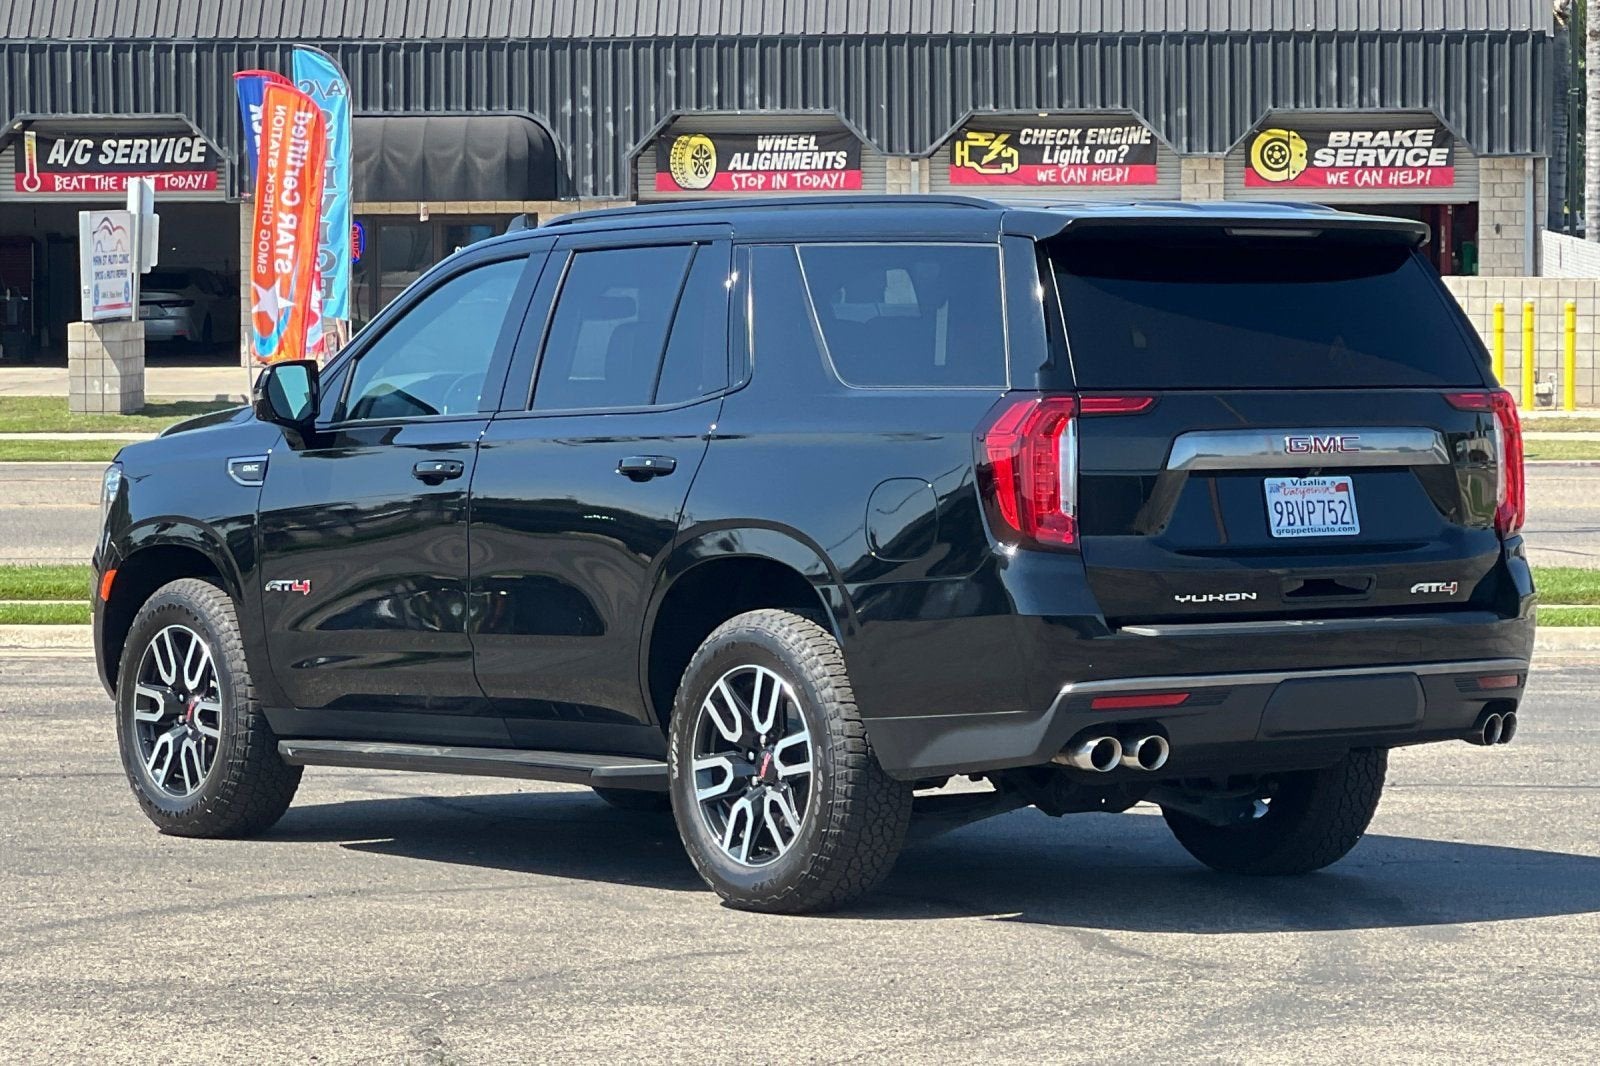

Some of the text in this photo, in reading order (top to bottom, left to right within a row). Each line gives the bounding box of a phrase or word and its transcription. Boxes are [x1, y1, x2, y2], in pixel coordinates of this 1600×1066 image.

[757, 134, 819, 152] WHEEL
[1019, 126, 1152, 146] CHECK ENGINE
[1327, 129, 1436, 148] BRAKE
[47, 137, 207, 167] A/C SERVICE
[728, 151, 847, 171] ALIGNMENTS
[1042, 145, 1130, 168] Light on?
[1313, 147, 1449, 168] SERVICE
[54, 174, 91, 191] BEAT
[90, 174, 118, 190] THE
[122, 174, 160, 190] HT
[731, 172, 766, 190] STOP
[771, 173, 787, 189] IN
[1037, 167, 1129, 184] WE CAN HELP!
[1326, 169, 1432, 187] WE CAN HELP!
[1284, 435, 1361, 455] GMC
[242, 464, 259, 472] GMC
[1290, 478, 1327, 486] Visalia
[1273, 500, 1350, 527] 9BVP752
[1275, 526, 1356, 535] groppettiauto.com
[265, 579, 311, 595] AT4
[1410, 581, 1458, 596] AT4
[1174, 592, 1257, 603] YUKON
